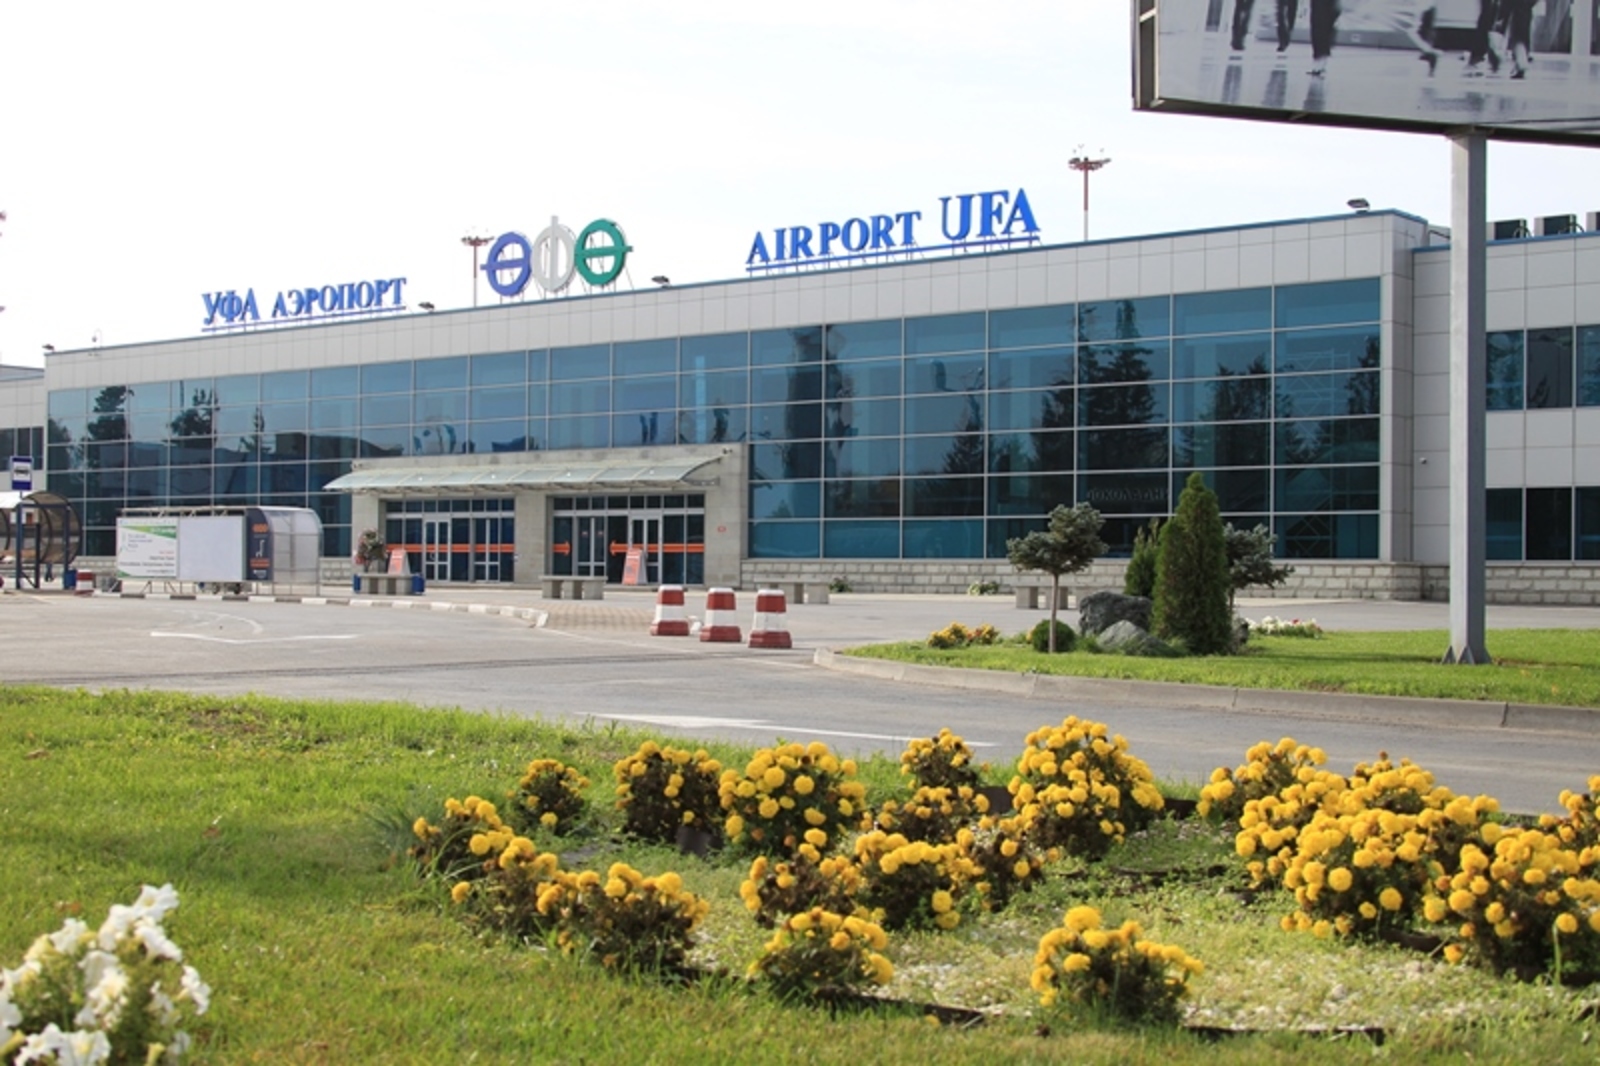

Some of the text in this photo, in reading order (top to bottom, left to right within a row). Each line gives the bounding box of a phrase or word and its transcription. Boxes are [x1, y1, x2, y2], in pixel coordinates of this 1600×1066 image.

[746, 187, 1041, 264] AIRPORT UFA
[202, 277, 407, 325] УФА АЭРОПОРТ
